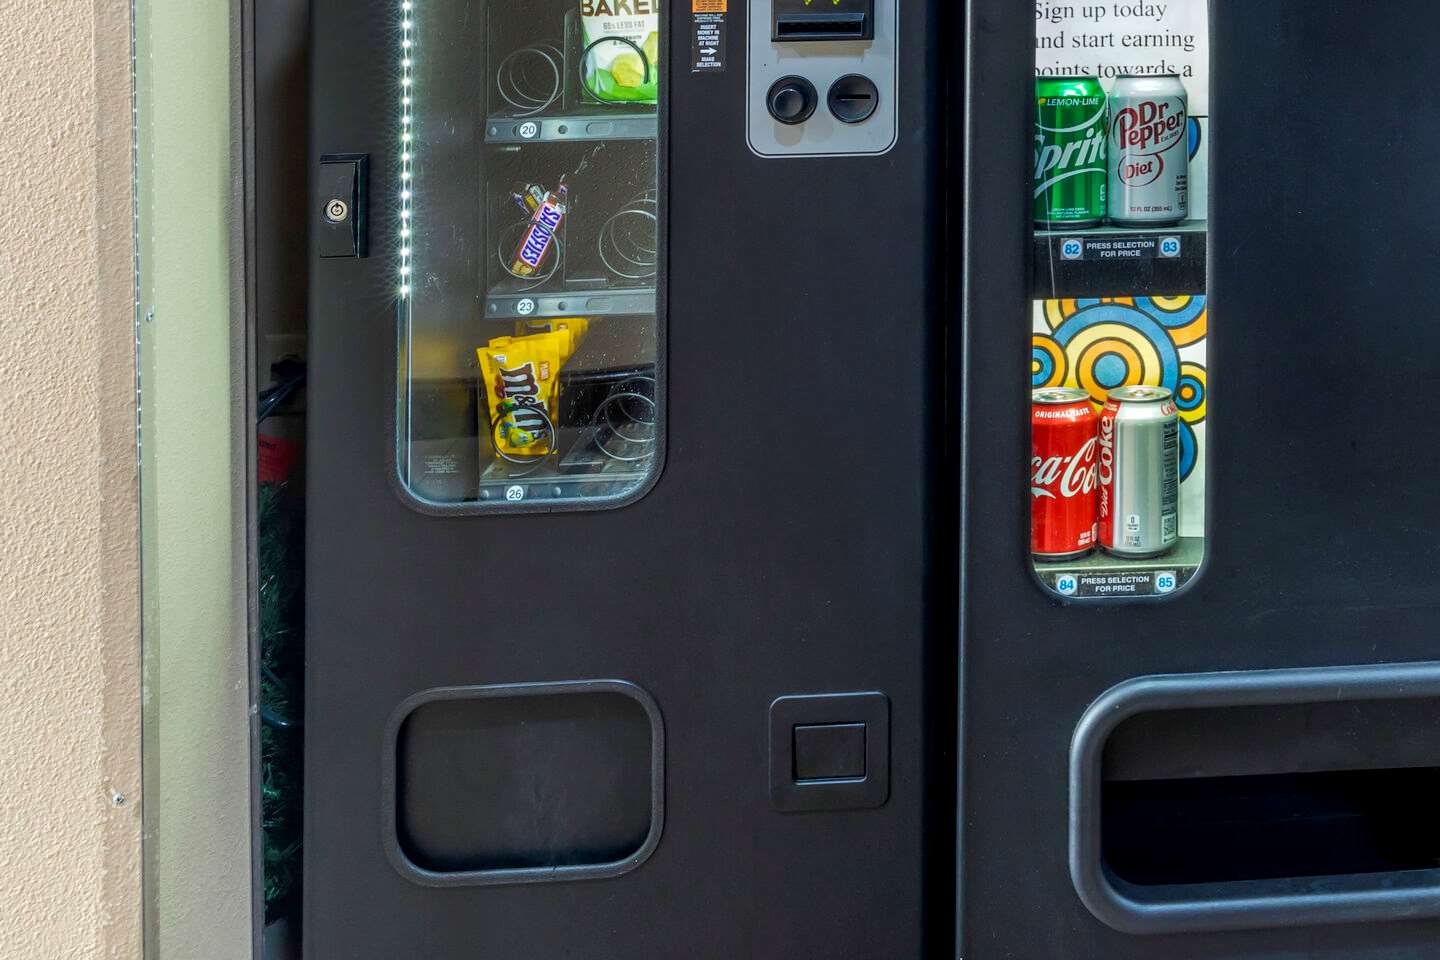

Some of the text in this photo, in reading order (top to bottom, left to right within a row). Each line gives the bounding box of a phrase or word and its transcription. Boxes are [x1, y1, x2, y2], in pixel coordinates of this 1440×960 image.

[1036, 0, 1167, 23] Sign up today
[1072, 32, 1115, 48] start
[1121, 29, 1195, 51] earning
[1182, 64, 1193, 77] a
[1047, 98, 1099, 106] LEMON-LIME
[1139, 101, 1168, 127] Dr
[522, 123, 535, 136] 20
[1116, 107, 1184, 150] Pepper
[1125, 161, 1152, 179] Diet
[1064, 244, 1079, 255] 82
[1113, 241, 1154, 249] SELECTION
[1163, 242, 1177, 252] 83
[520, 301, 532, 313] 23
[1035, 409, 1071, 418] ORIGINAL
[1099, 416, 1113, 485] Coke
[508, 490, 522, 499] 26
[1059, 580, 1074, 590] 84
[1158, 577, 1173, 587] 85
